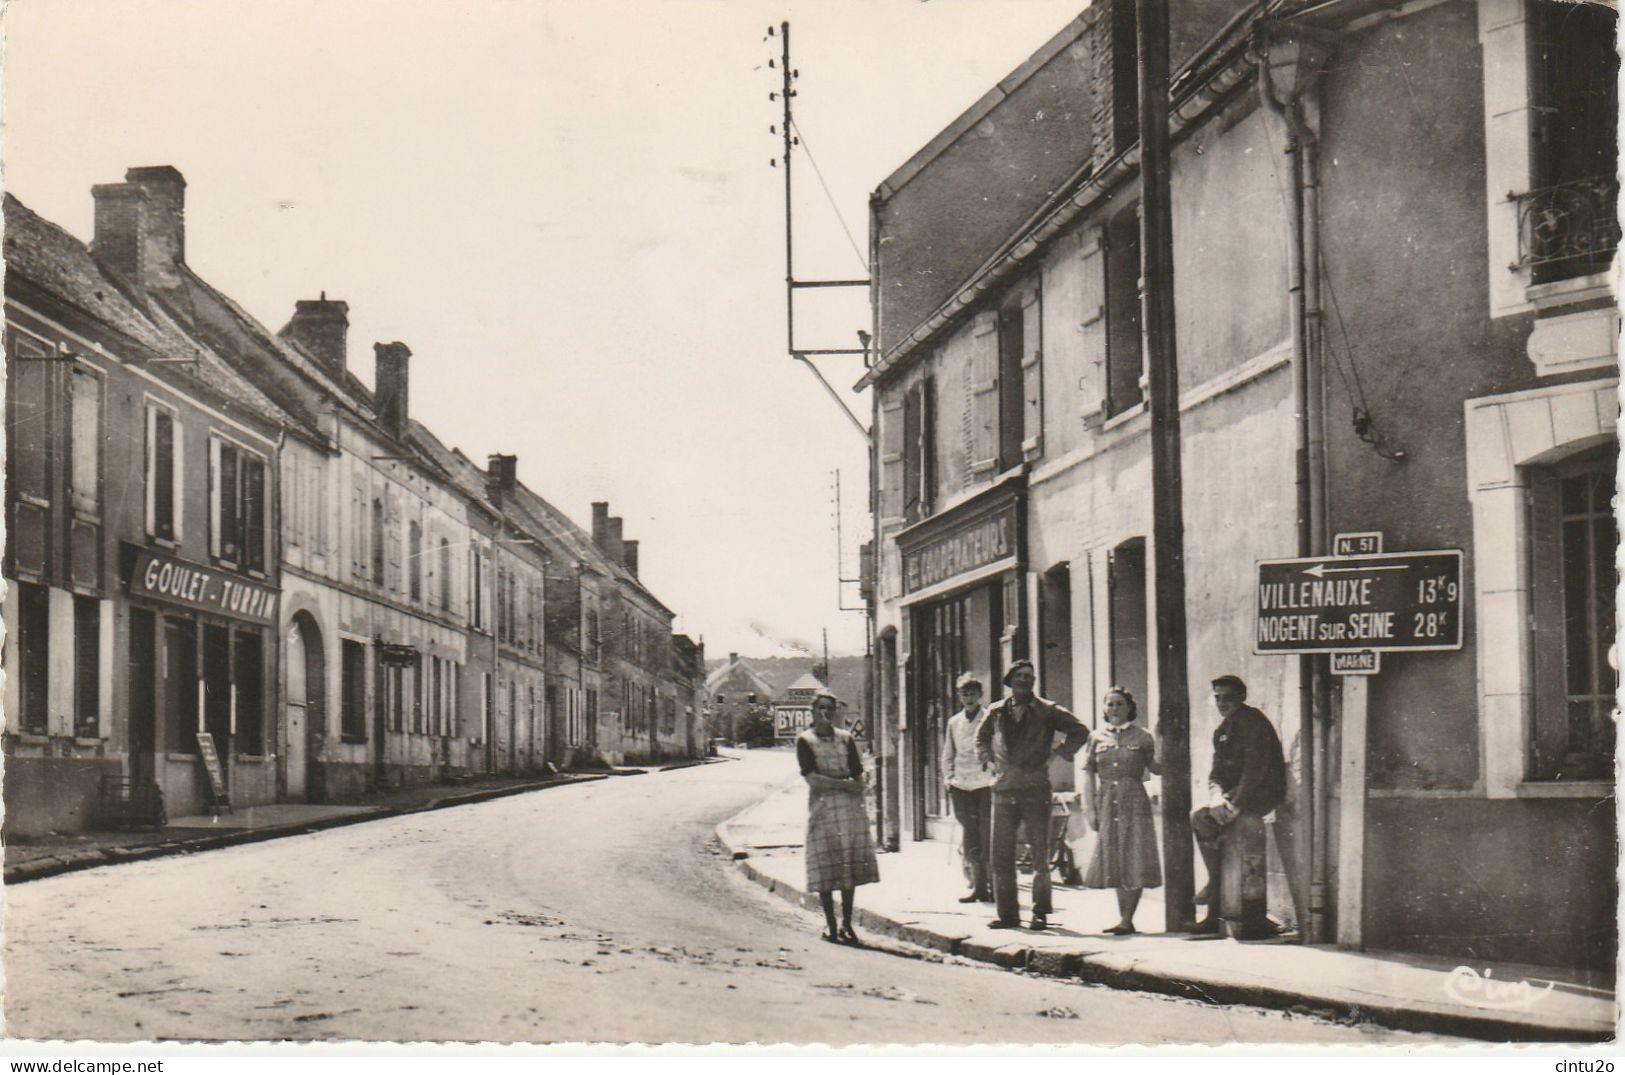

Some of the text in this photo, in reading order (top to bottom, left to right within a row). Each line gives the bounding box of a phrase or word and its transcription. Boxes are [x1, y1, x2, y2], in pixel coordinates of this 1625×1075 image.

[1341, 538, 1374, 553] N. 51
[145, 558, 210, 603] GOULET
[221, 581, 276, 619] TURPIN
[1259, 578, 1371, 609] VILLENAUXE
[1258, 614, 1319, 642] NOGENT
[1319, 622, 1345, 641] SUR
[1347, 611, 1395, 640] SEINE
[777, 710, 814, 730] BYRR
